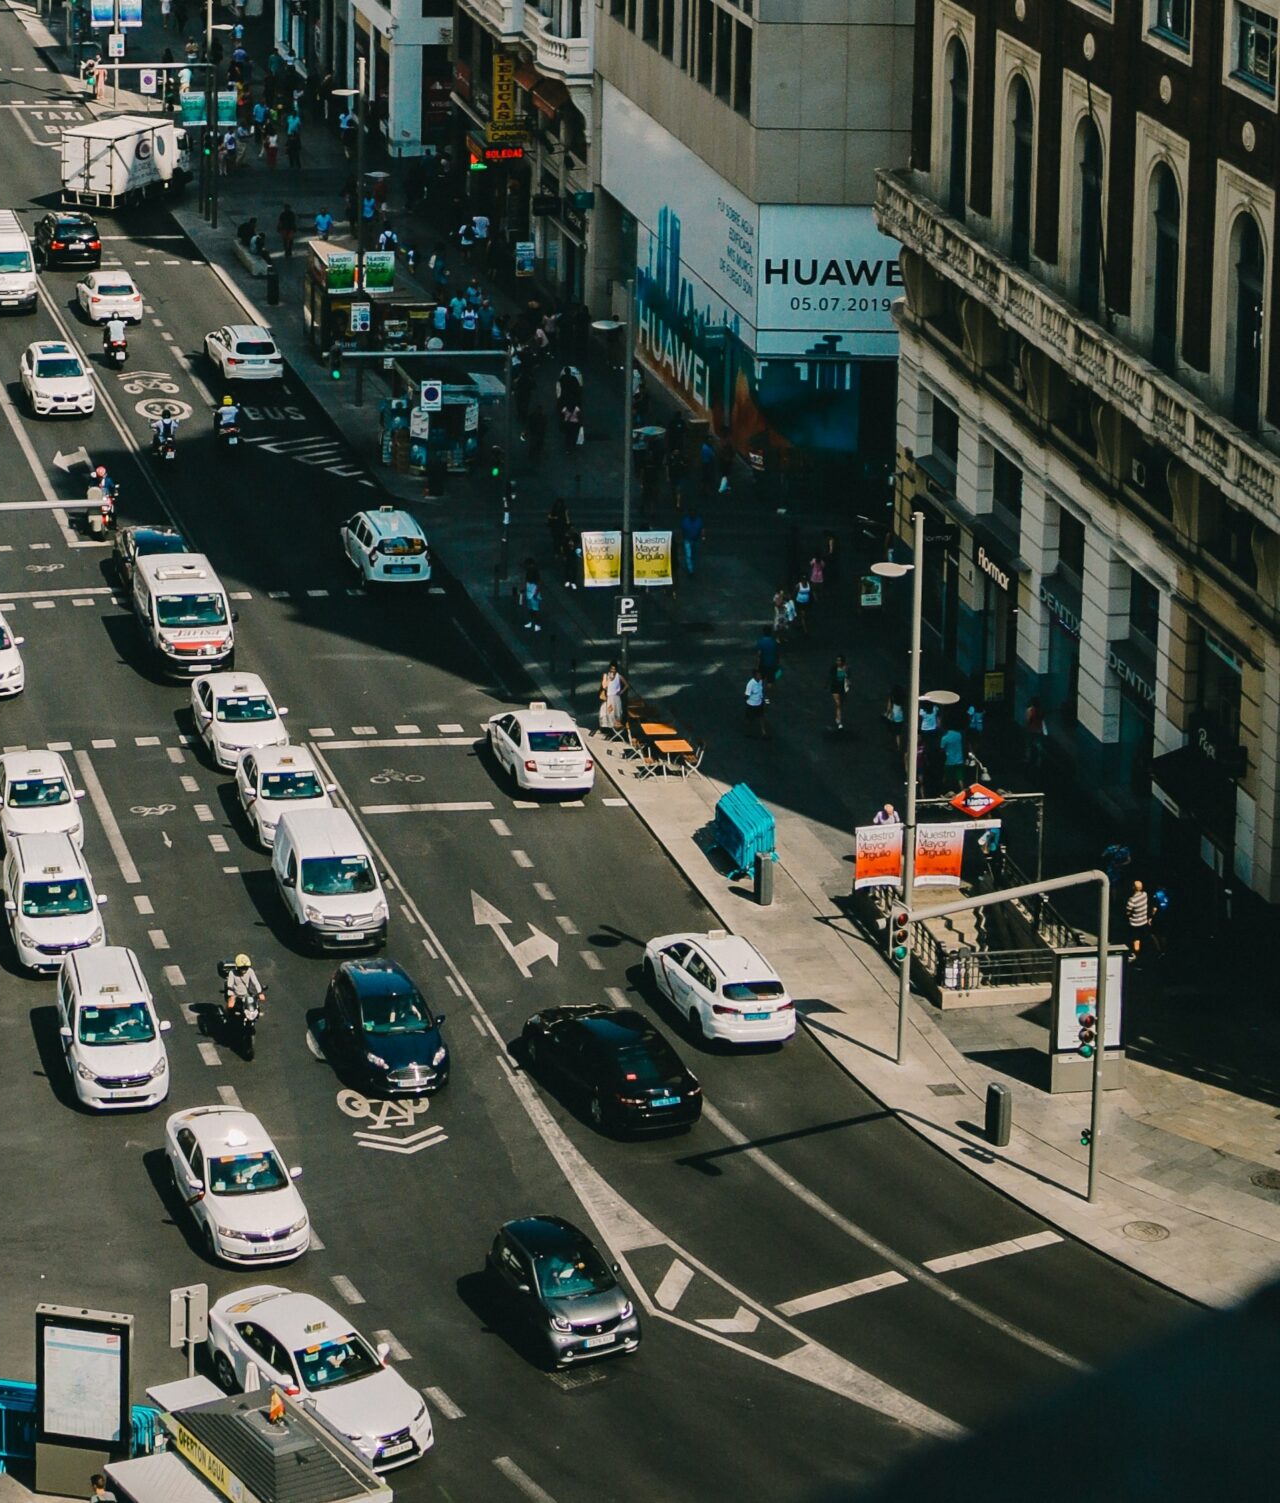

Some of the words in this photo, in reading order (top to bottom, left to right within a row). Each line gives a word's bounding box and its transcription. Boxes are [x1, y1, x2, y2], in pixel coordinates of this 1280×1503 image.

[497, 54, 512, 120] PELUCAS
[31, 111, 84, 121] TAXI
[44, 125, 78, 134] BU
[765, 259, 904, 286] HUAWE
[790, 297, 891, 312] 05.07.2019
[639, 300, 710, 412] HUAWEI
[148, 403, 179, 415] 30
[242, 406, 306, 421] BUS
[584, 537, 615, 545] Nuestro
[635, 536, 665, 544] Nuestro
[585, 545, 609, 554] Mayor
[635, 545, 660, 554] Mayor
[586, 553, 614, 561] Orgullo
[635, 553, 664, 562] Orgullo
[621, 598, 635, 614] P
[1040, 584, 1081, 632] DENTIX
[1108, 650, 1156, 701] DENTIX
[858, 830, 895, 840] Nuestro
[919, 829, 956, 839] Nuestro
[858, 841, 887, 851] Mayor
[918, 839, 948, 848] Mayor
[858, 849, 891, 861] Orgullo
[917, 848, 952, 859] Orgullo
[178, 1427, 207, 1468] OFERTON
[208, 1455, 225, 1485] AGUA
